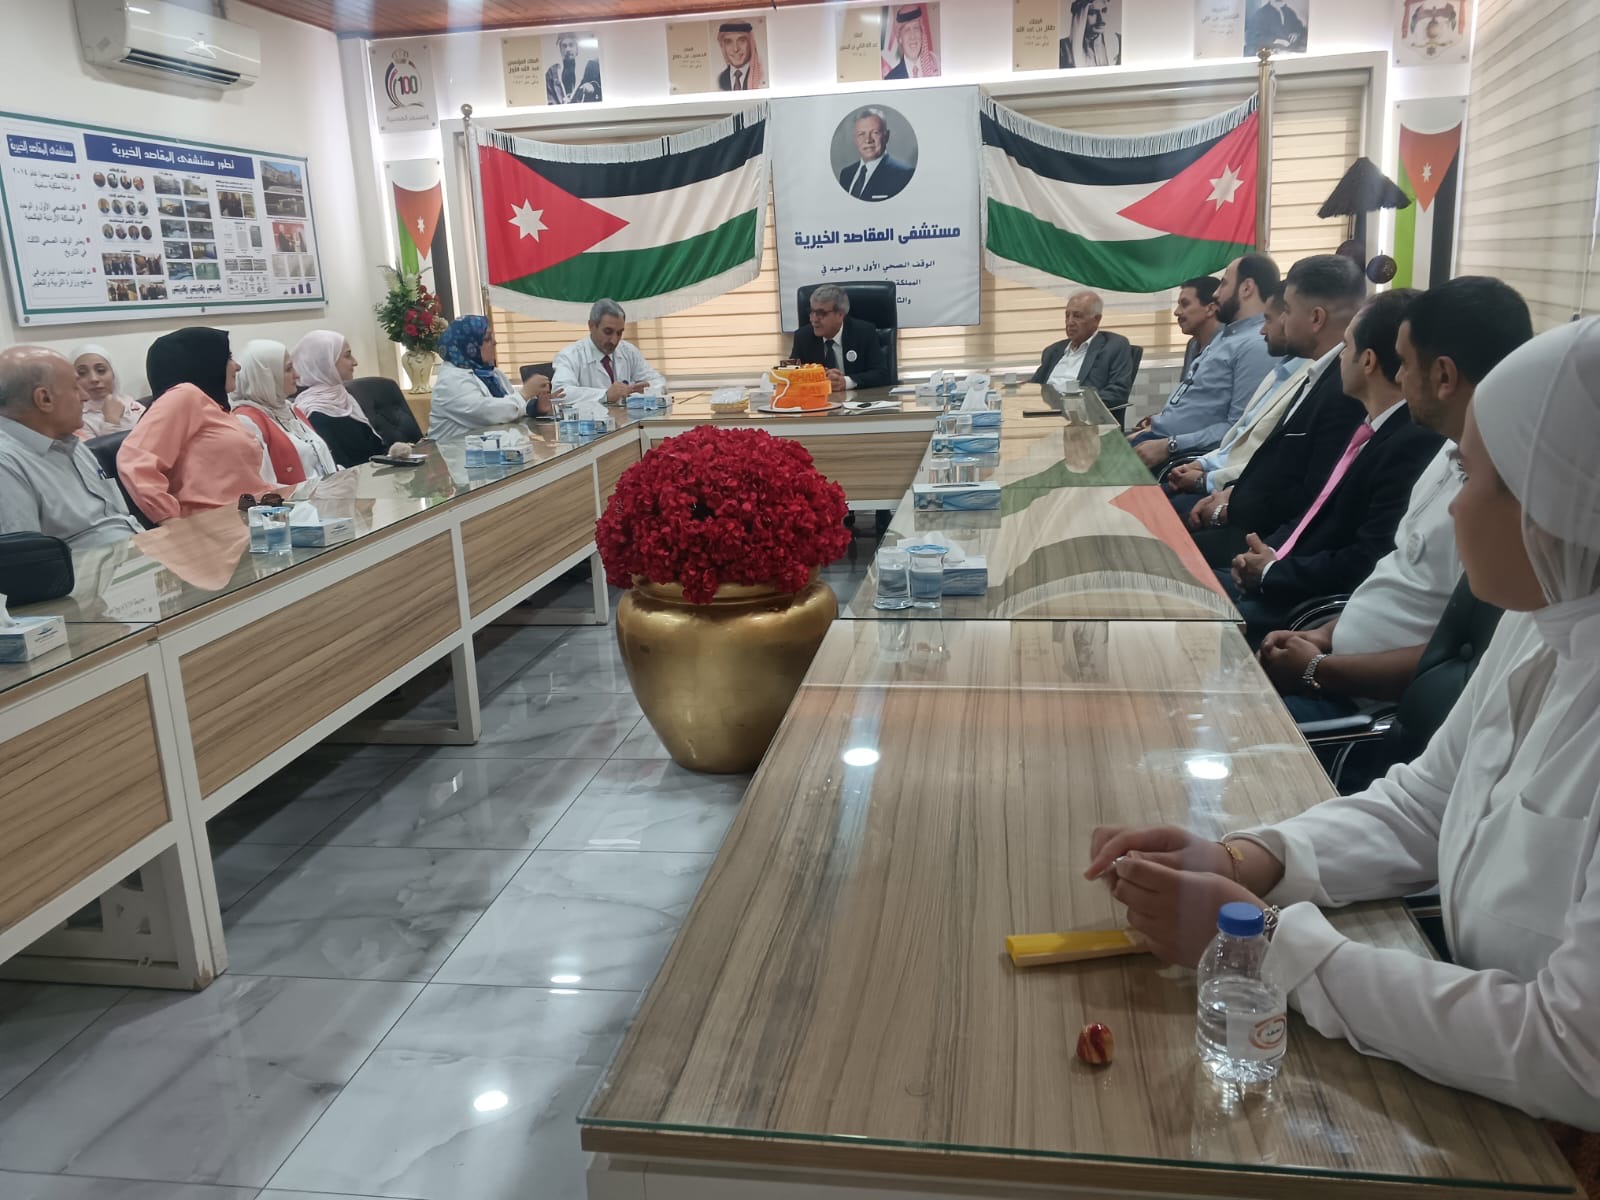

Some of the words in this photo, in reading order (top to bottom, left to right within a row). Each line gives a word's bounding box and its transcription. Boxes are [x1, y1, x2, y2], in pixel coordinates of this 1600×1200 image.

[397, 75, 418, 95] 100
[111, 142, 142, 160] الخيرية
[144, 148, 175, 164] المقاصد
[177, 153, 215, 167] مستشفى
[217, 157, 235, 170] تطور
[794, 230, 840, 249] الخيرية
[843, 227, 894, 243] المقاصد
[898, 222, 961, 244] مستشفى
[820, 265, 828, 276] في
[829, 264, 854, 273] الوحيد
[863, 260, 880, 272] الأول
[882, 261, 909, 273] الصحي
[912, 258, 935, 269] الوقف
